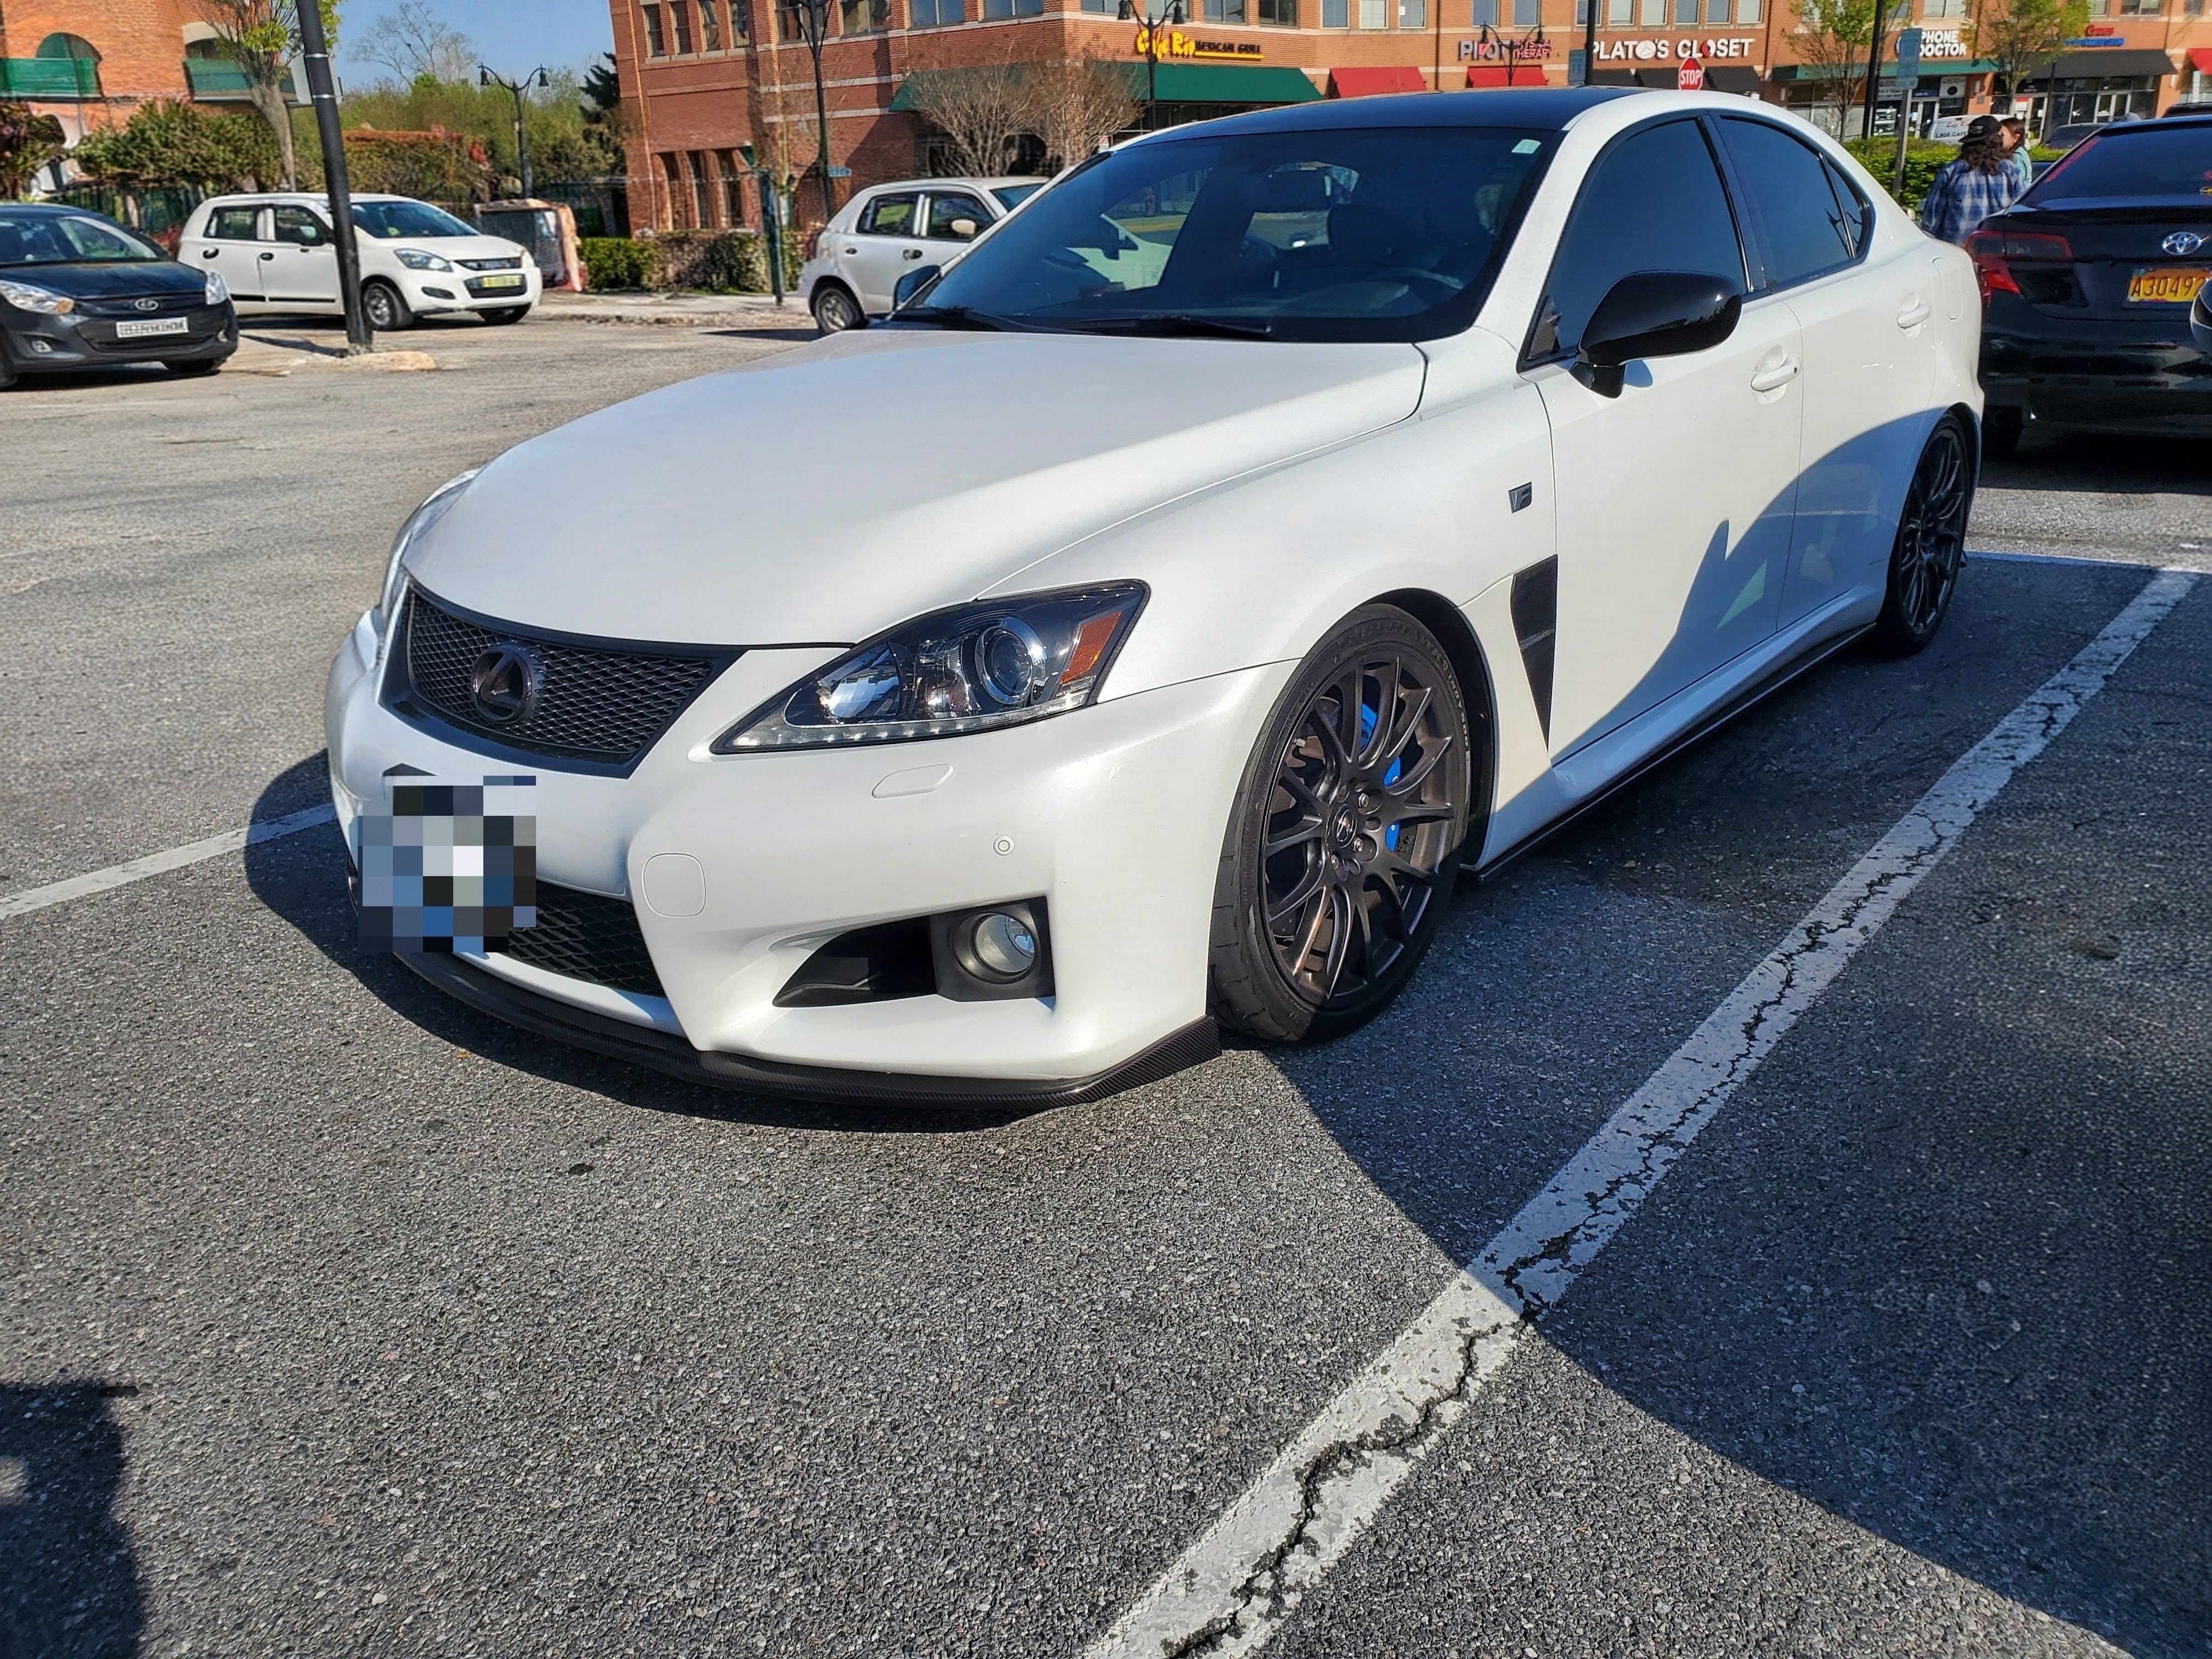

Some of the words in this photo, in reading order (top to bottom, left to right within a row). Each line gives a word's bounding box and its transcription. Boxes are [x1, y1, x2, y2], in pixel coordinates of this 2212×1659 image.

[1172, 31, 1195, 55] Rio
[1921, 30, 1959, 43] PHONE
[1460, 40, 1510, 59] PIVOT
[1513, 48, 1552, 59] THERAPY
[1677, 38, 1754, 59] CLOSET
[1681, 69, 1701, 85] STOP
